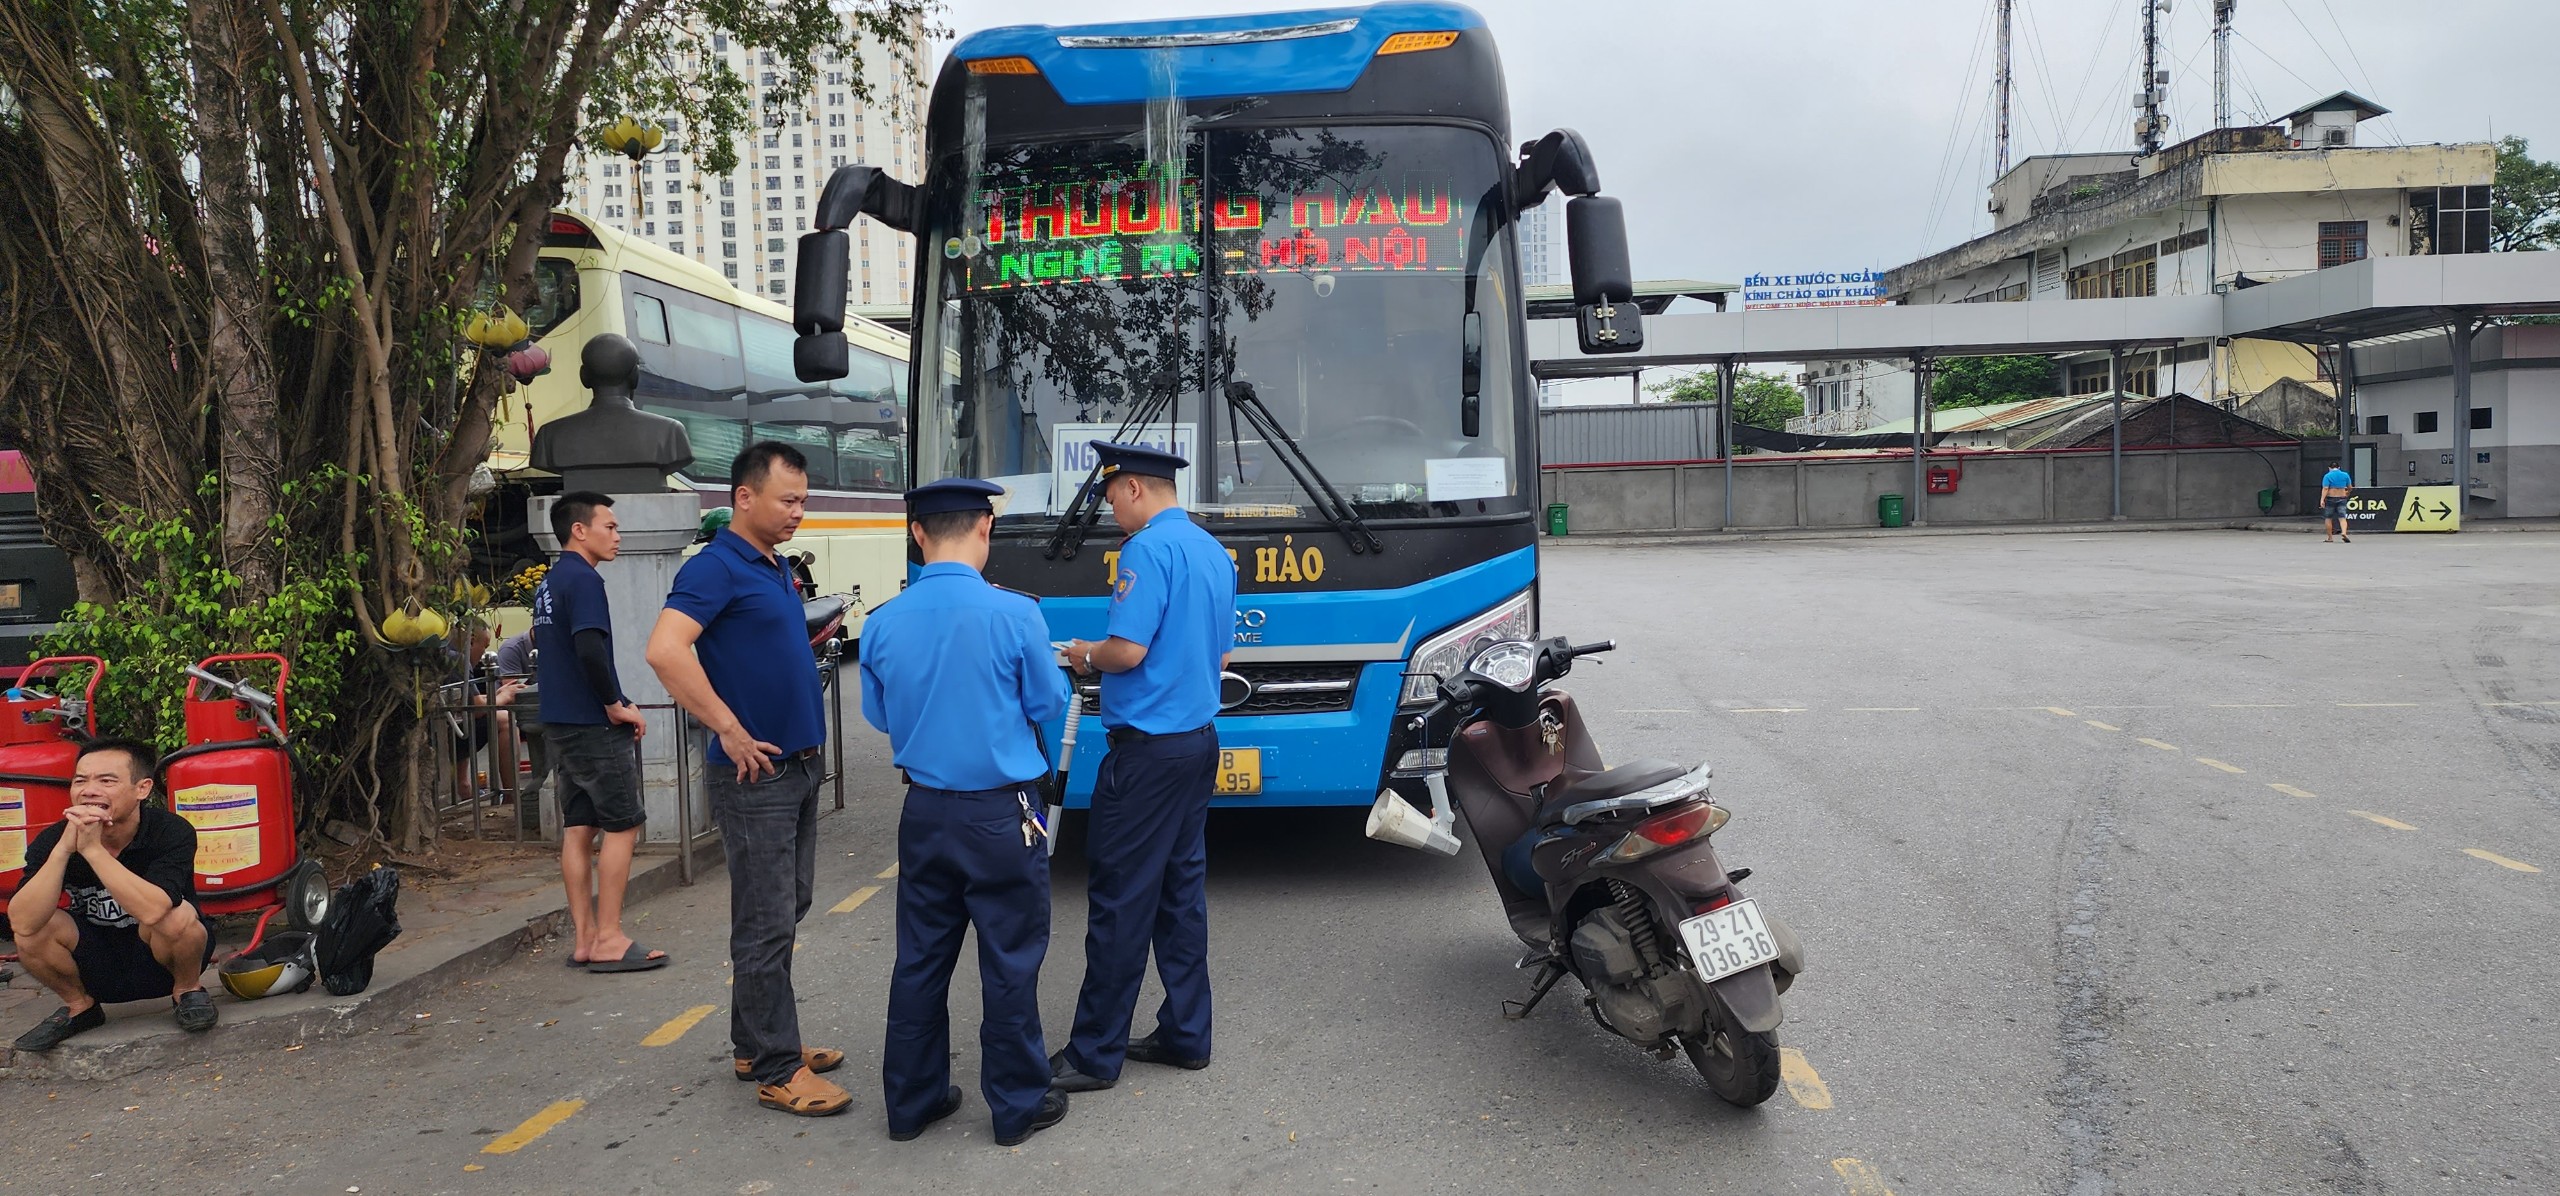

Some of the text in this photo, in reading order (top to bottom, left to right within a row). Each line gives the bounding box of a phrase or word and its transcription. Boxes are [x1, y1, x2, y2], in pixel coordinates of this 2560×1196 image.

[1345, 227, 1427, 270] NỘI
[1775, 276, 1790, 286] XE
[1777, 288, 1811, 299] CHÀO
[2367, 500, 2387, 510] RA
[1255, 535, 1324, 583] HẢO
[1692, 906, 1753, 948] 29-Z1
[1699, 932, 1772, 977] 036.36
